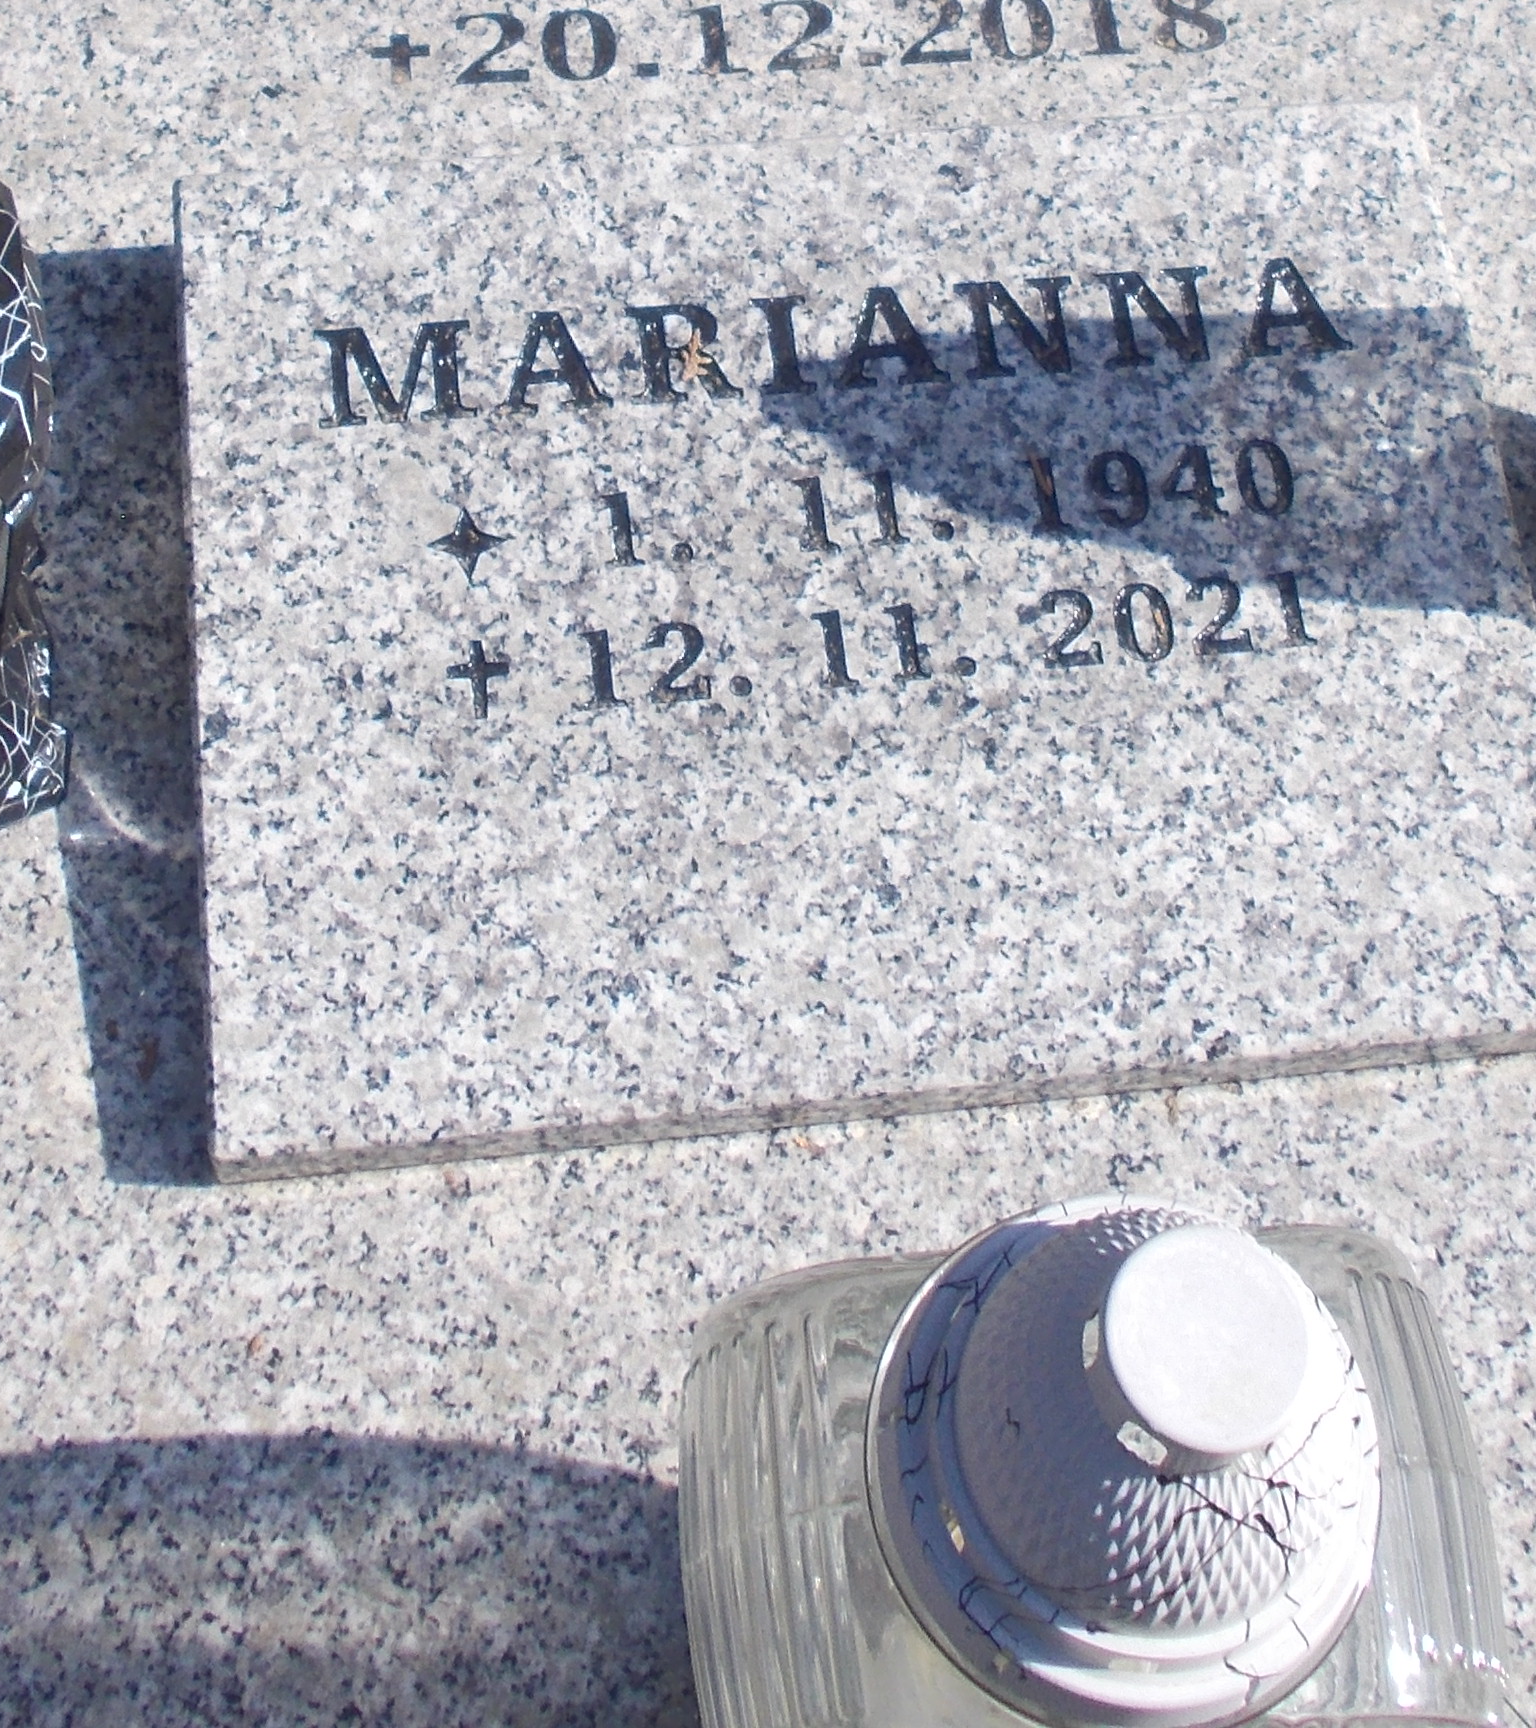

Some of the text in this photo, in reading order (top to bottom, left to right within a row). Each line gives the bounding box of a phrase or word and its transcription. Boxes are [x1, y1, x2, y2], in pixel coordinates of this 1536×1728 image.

[314, 256, 1353, 429] MARIANNA
[1022, 438, 1296, 535] 1940
[579, 619, 754, 710] 12.
[1034, 570, 1319, 670] 2021
